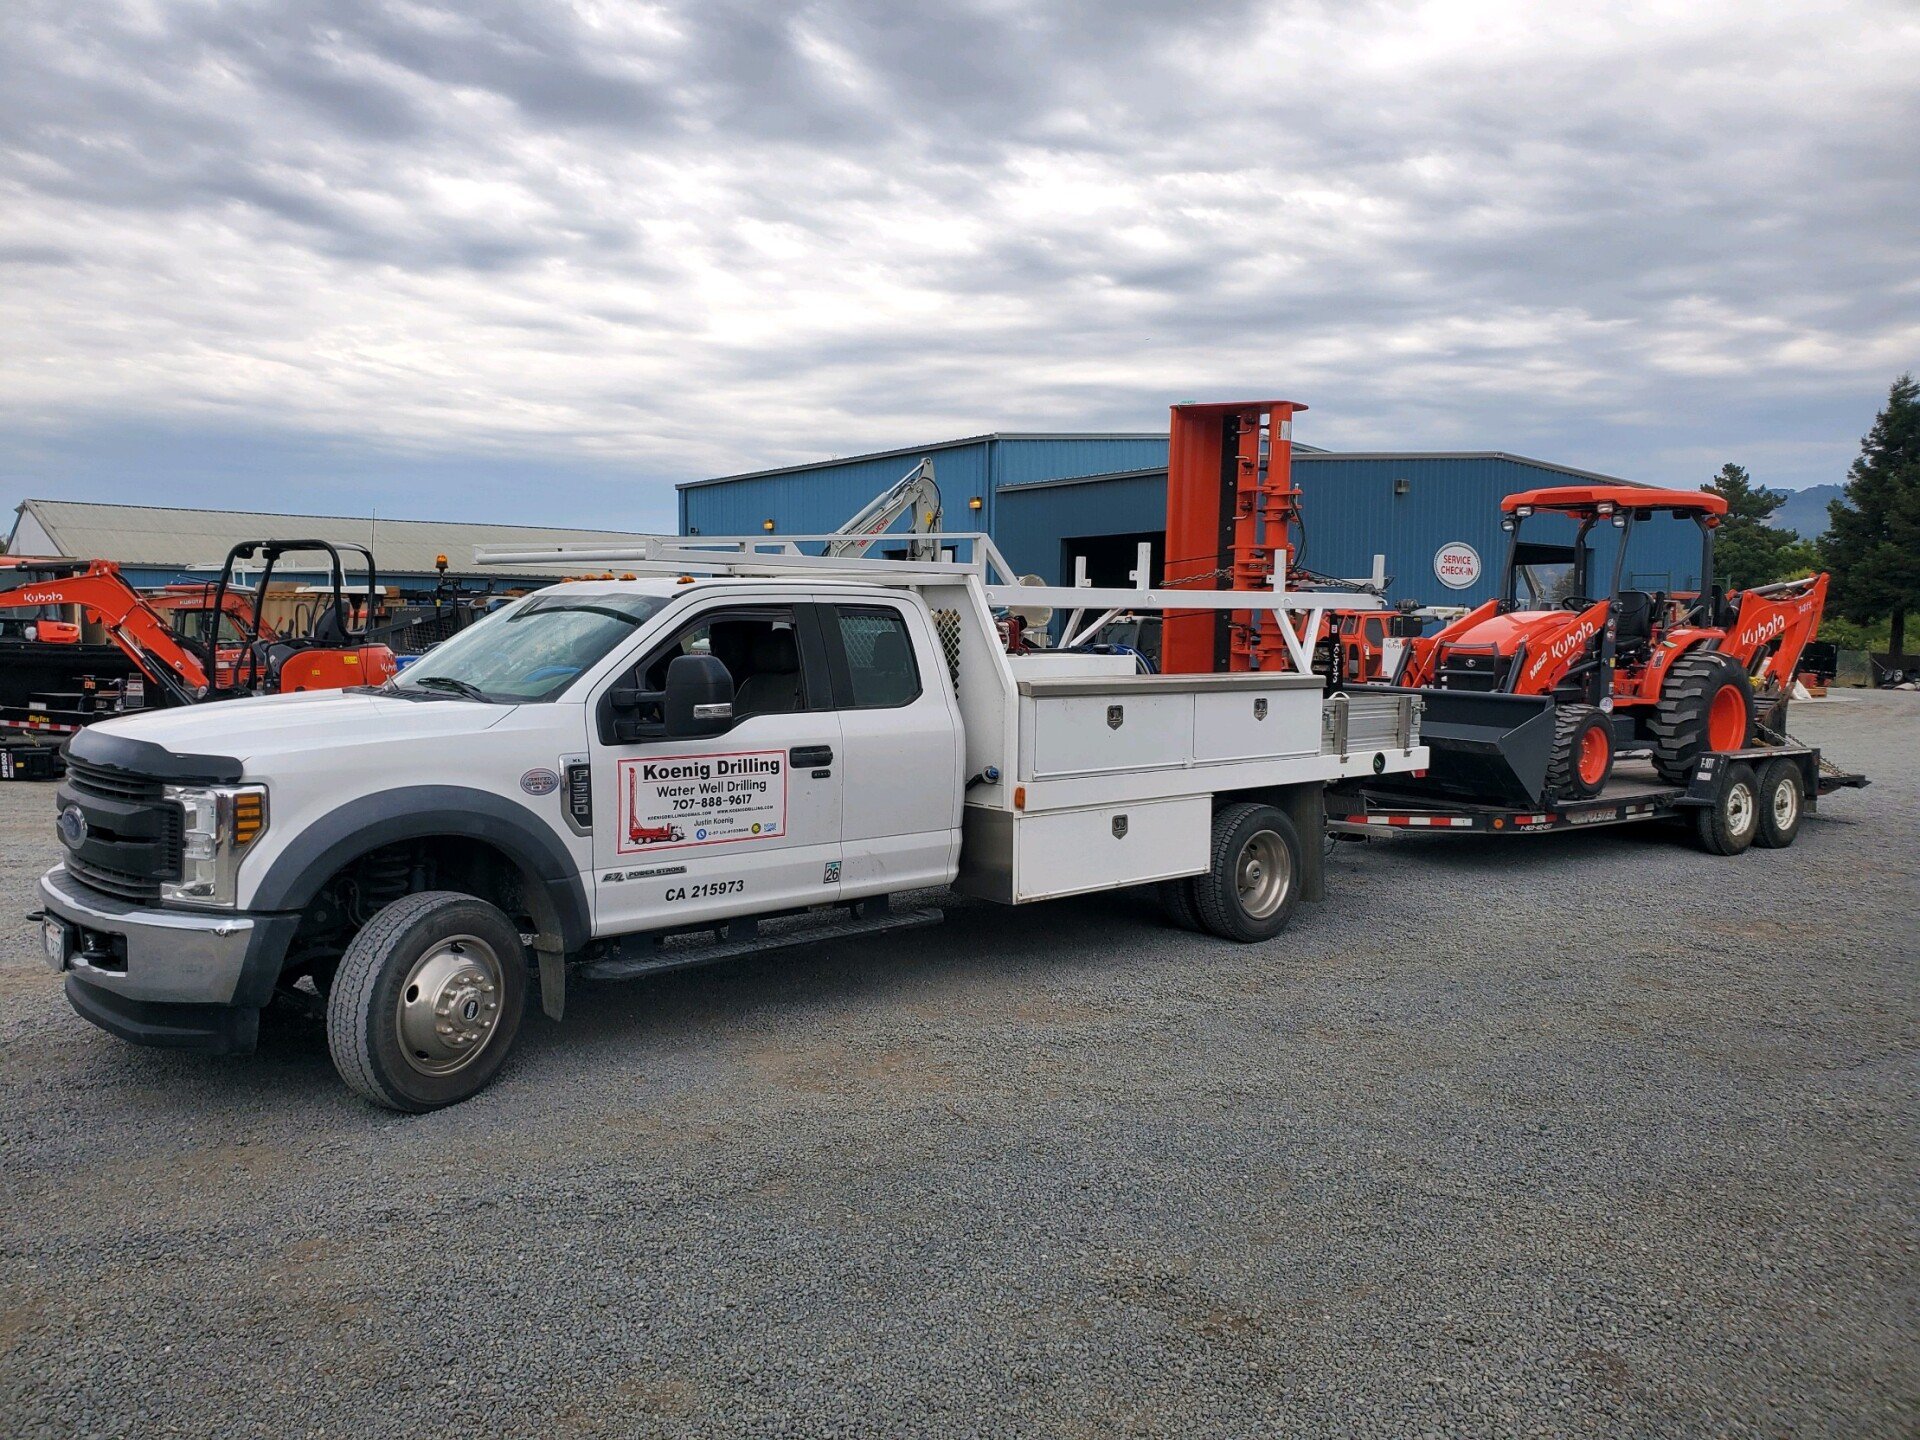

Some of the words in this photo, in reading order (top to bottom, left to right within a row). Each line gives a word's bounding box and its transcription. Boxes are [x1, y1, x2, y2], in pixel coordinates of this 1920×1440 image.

[1443, 554, 1471, 565] SERVICE
[1440, 565, 1474, 576] CHECK-IN
[23, 591, 63, 602] Kubota
[1742, 613, 1785, 646] Kubota
[1551, 621, 1594, 658] Kubota
[1332, 643, 1340, 683] Kubota
[1529, 651, 1548, 680] M62
[643, 762, 710, 780] Koenig
[717, 758, 780, 775] Drilling
[656, 785, 695, 798] Water
[699, 781, 723, 794] Well
[727, 779, 767, 793] Drilling
[672, 794, 752, 811] 707-888-9617
[694, 819, 712, 827] Justin
[713, 817, 734, 825] Koenig
[628, 869, 655, 877] POWER
[655, 866, 686, 875] STROKE
[825, 867, 839, 881] 26
[665, 887, 686, 902] CA
[691, 880, 745, 898] 215973
